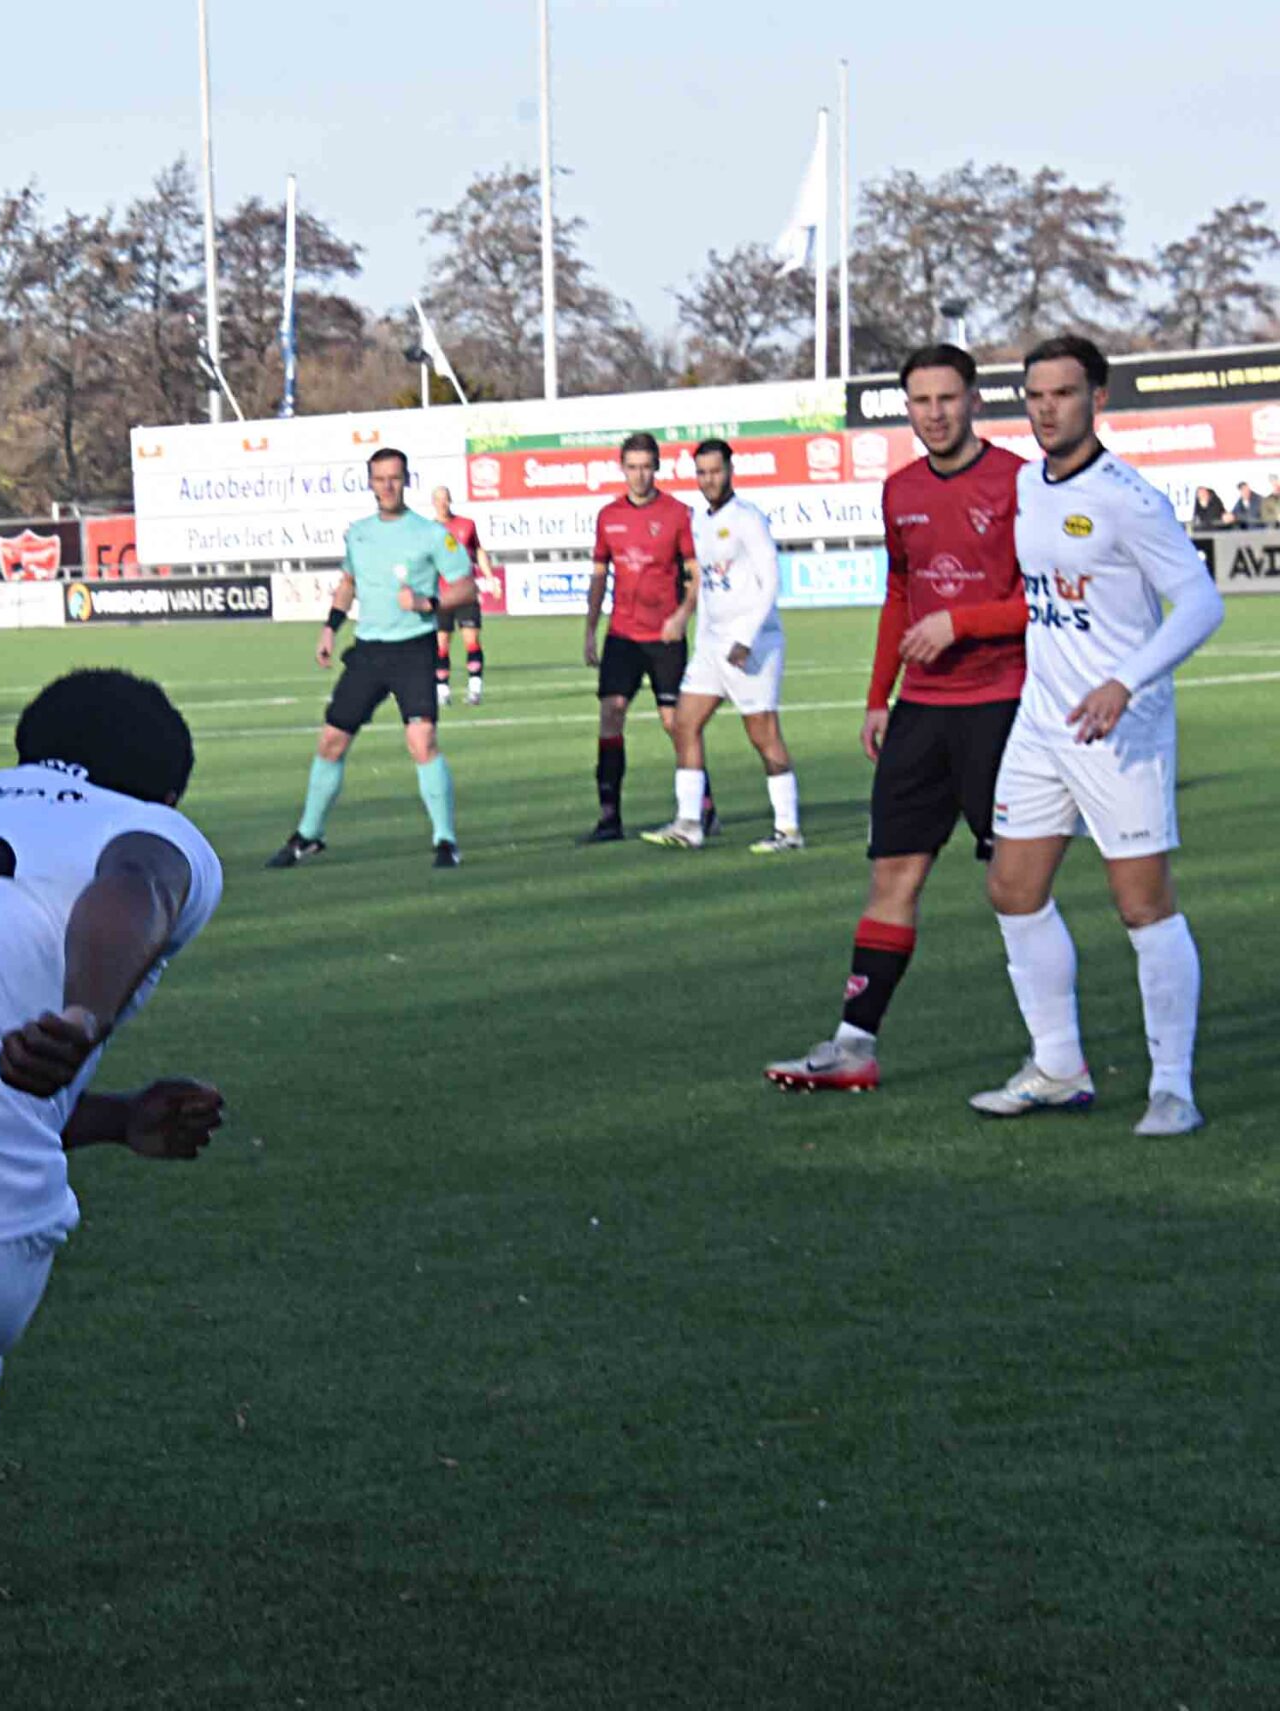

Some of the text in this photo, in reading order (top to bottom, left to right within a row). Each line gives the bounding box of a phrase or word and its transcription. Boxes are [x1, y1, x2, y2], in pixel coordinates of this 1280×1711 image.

[179, 470, 295, 502] Autobedrijf
[169, 588, 202, 613] VAN
[203, 587, 225, 611] DE
[227, 585, 270, 611] CLUB
